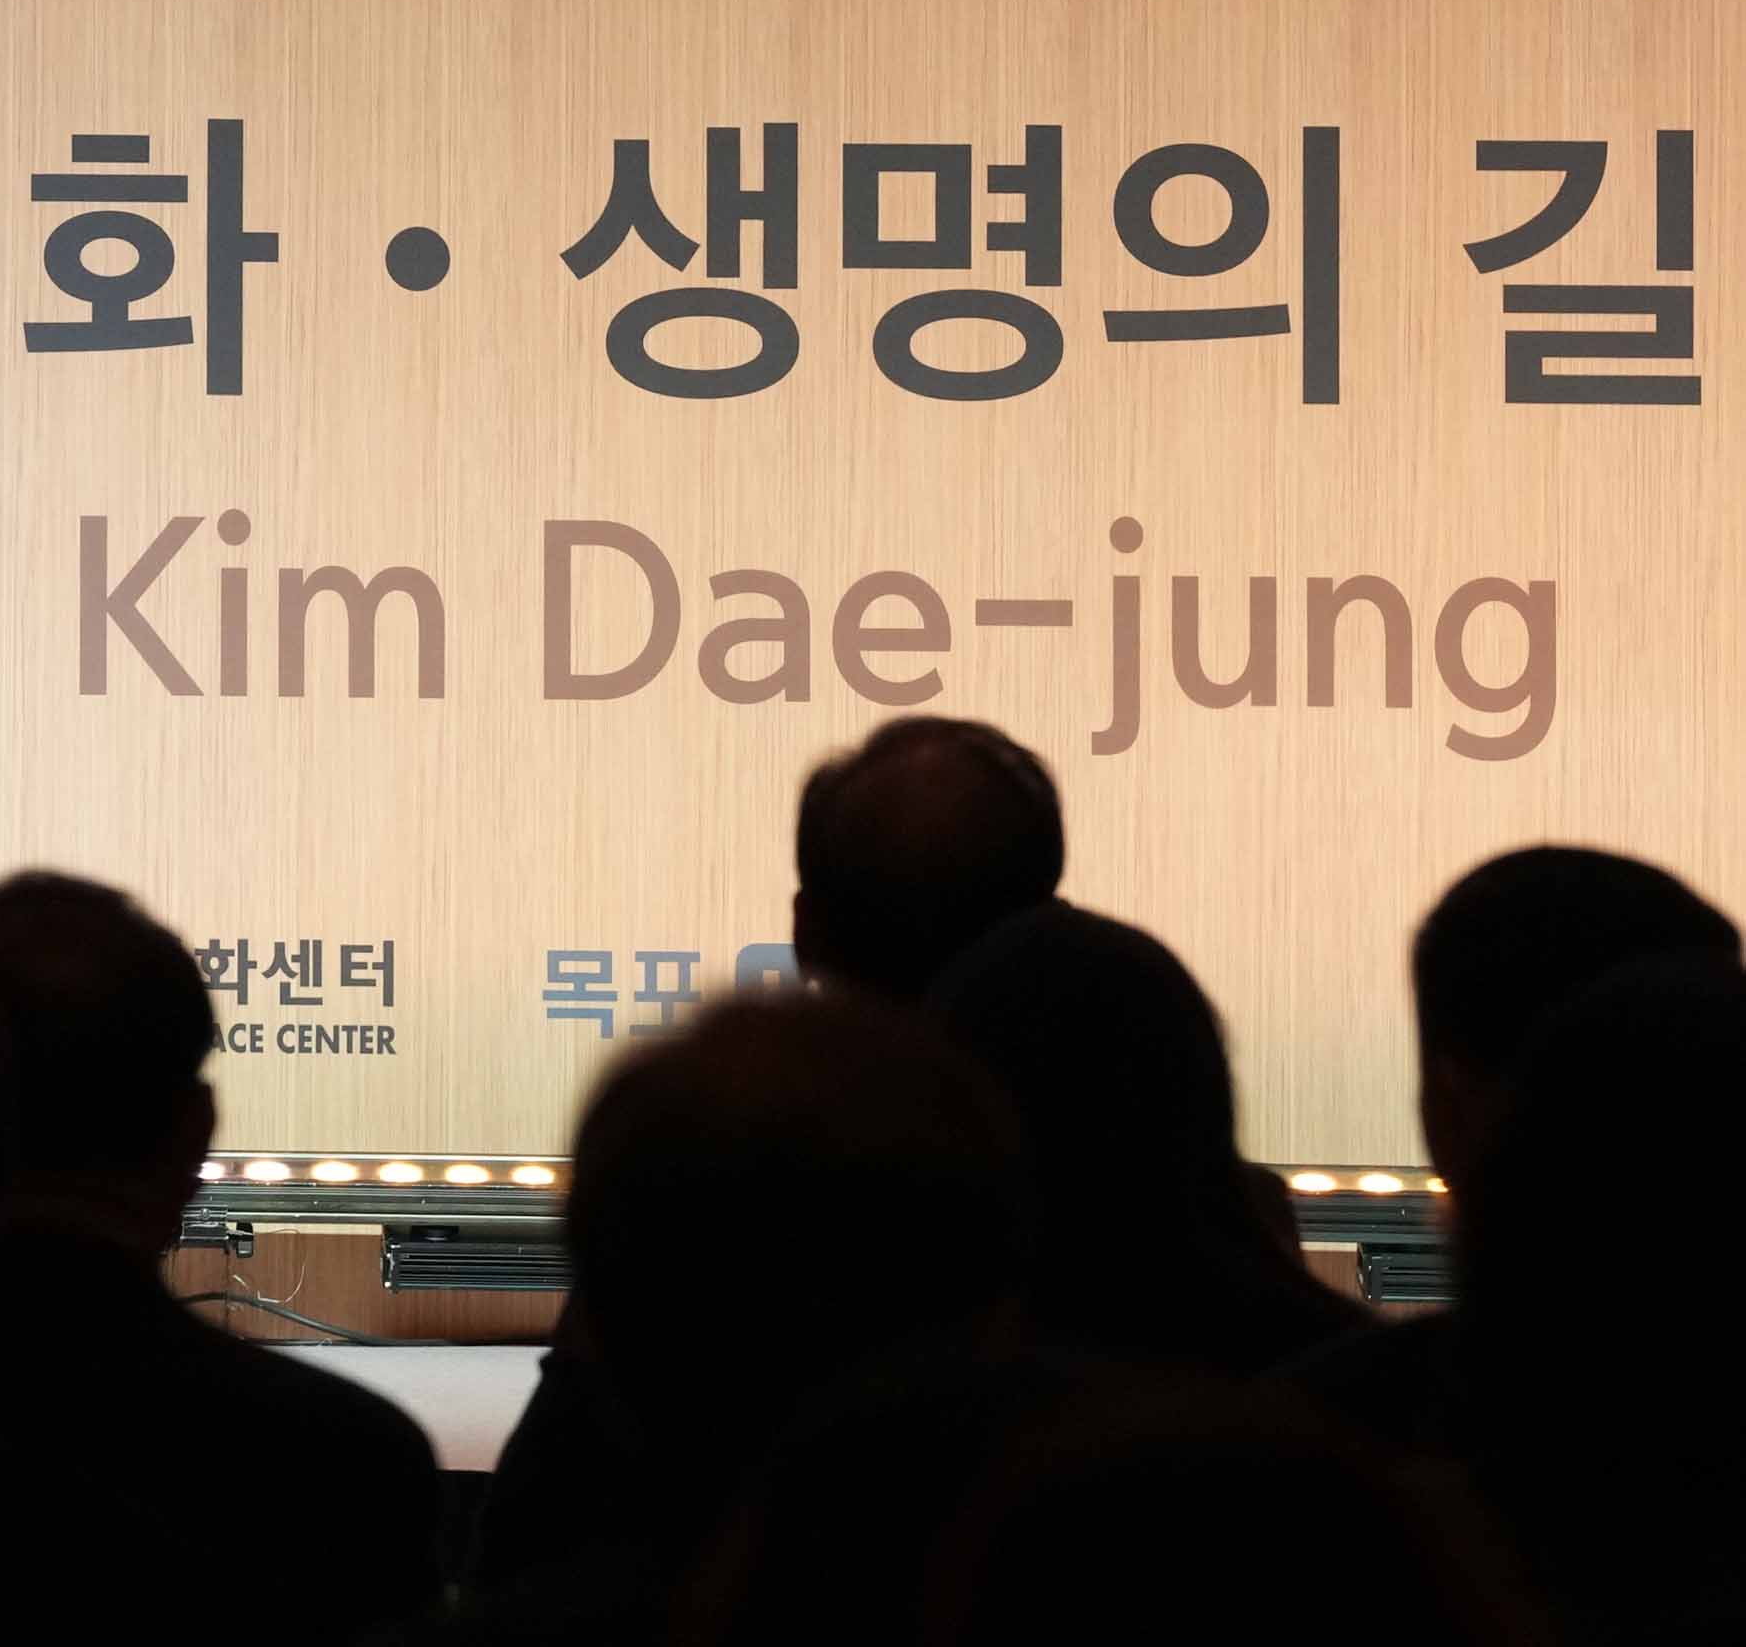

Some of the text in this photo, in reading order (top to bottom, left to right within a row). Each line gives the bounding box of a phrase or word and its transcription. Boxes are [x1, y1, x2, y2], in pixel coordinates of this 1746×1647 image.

[560, 122, 1341, 405] 생명의
[1463, 129, 1703, 407] 길
[79, 508, 446, 700] Kim
[542, 516, 1558, 762] Dae-jung
[276, 1023, 397, 1055] CENTER
